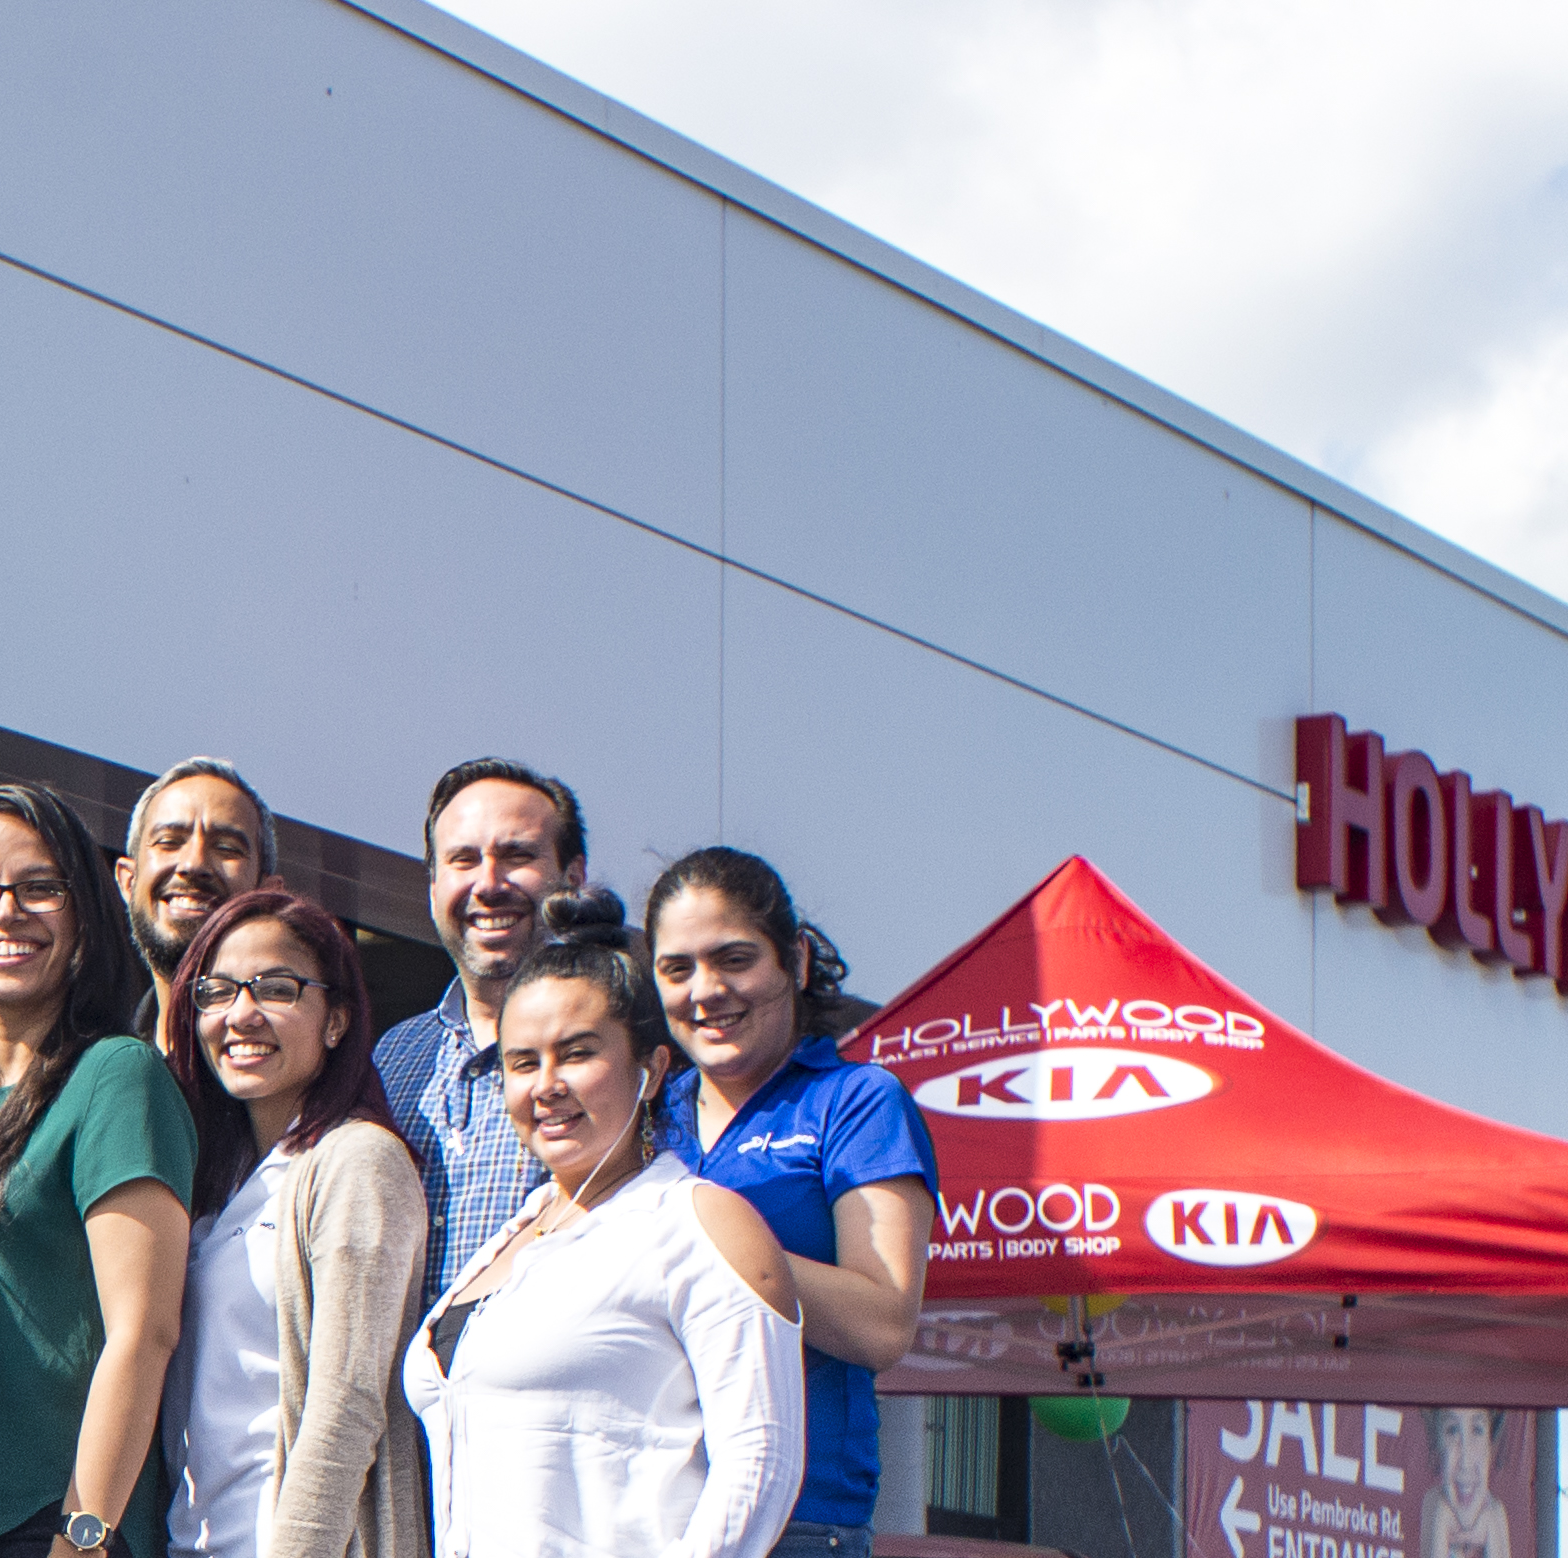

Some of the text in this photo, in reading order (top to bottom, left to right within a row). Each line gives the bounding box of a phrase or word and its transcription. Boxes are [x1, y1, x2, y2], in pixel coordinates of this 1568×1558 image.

[871, 998, 1265, 1058] HOLLYWOOD
[952, 1030, 1041, 1053] SERVICE
[1053, 1025, 1127, 1040] PARTS
[1202, 1031, 1265, 1050] SHOP
[957, 1065, 1171, 1107] KIA
[939, 1184, 1122, 1236] WOOD
[1171, 1199, 1295, 1246] KIA
[927, 1235, 1122, 1261] PARTS BODY SHOP
[1267, 1482, 1406, 1542] Use Pembroke Rd.
